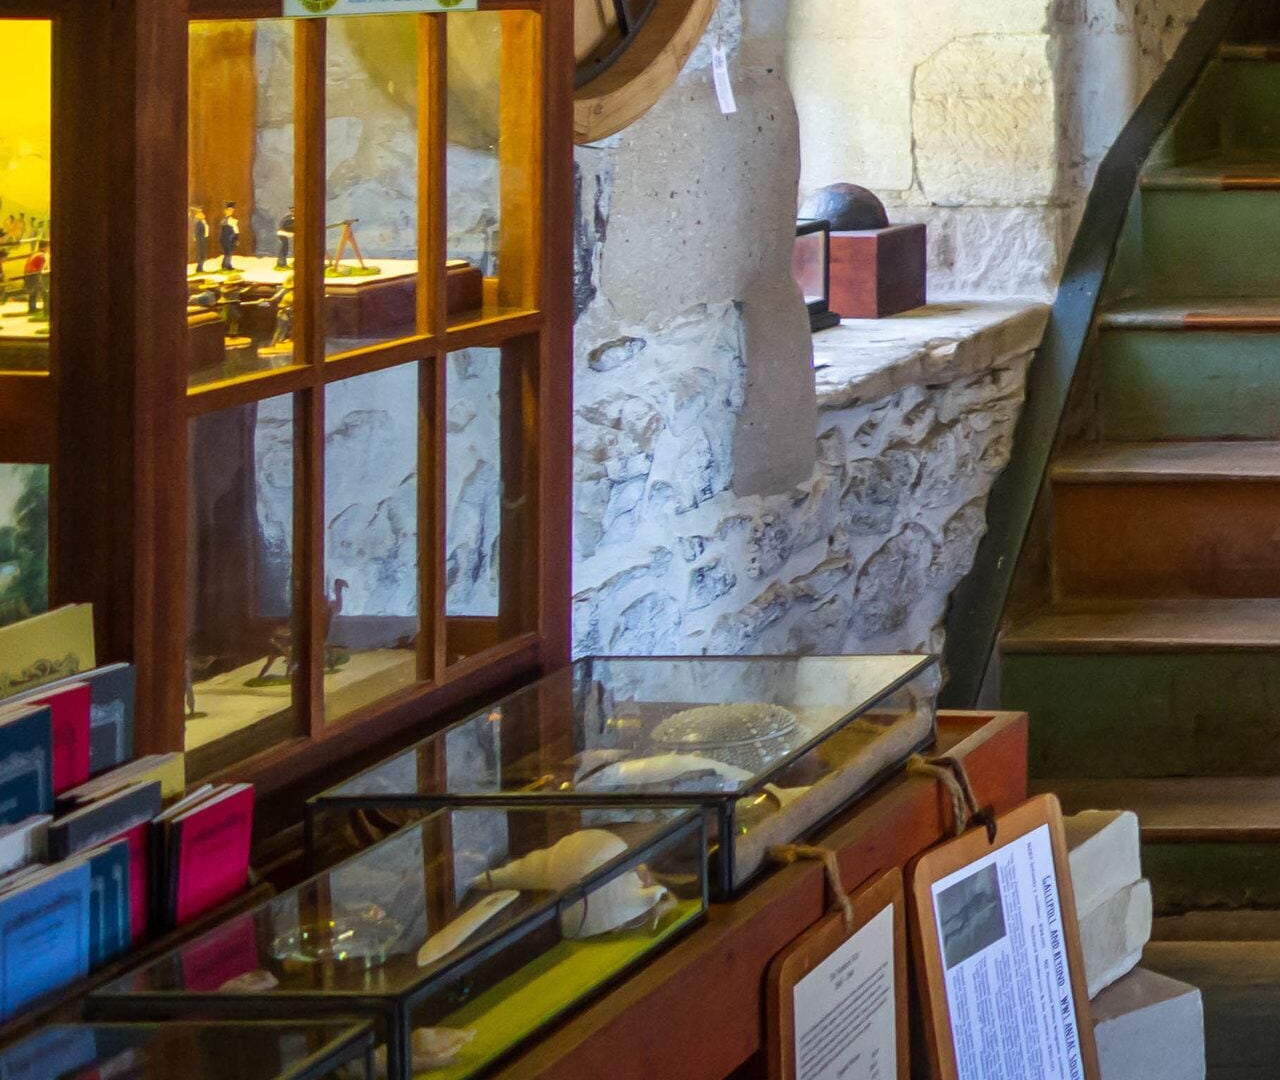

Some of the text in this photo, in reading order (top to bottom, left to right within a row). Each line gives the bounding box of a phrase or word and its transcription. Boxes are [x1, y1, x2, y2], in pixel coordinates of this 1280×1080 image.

[1041, 874, 1057, 926] GALLIPOLI
[1049, 927, 1060, 951] AND
[1052, 950, 1065, 988] BEYOND
